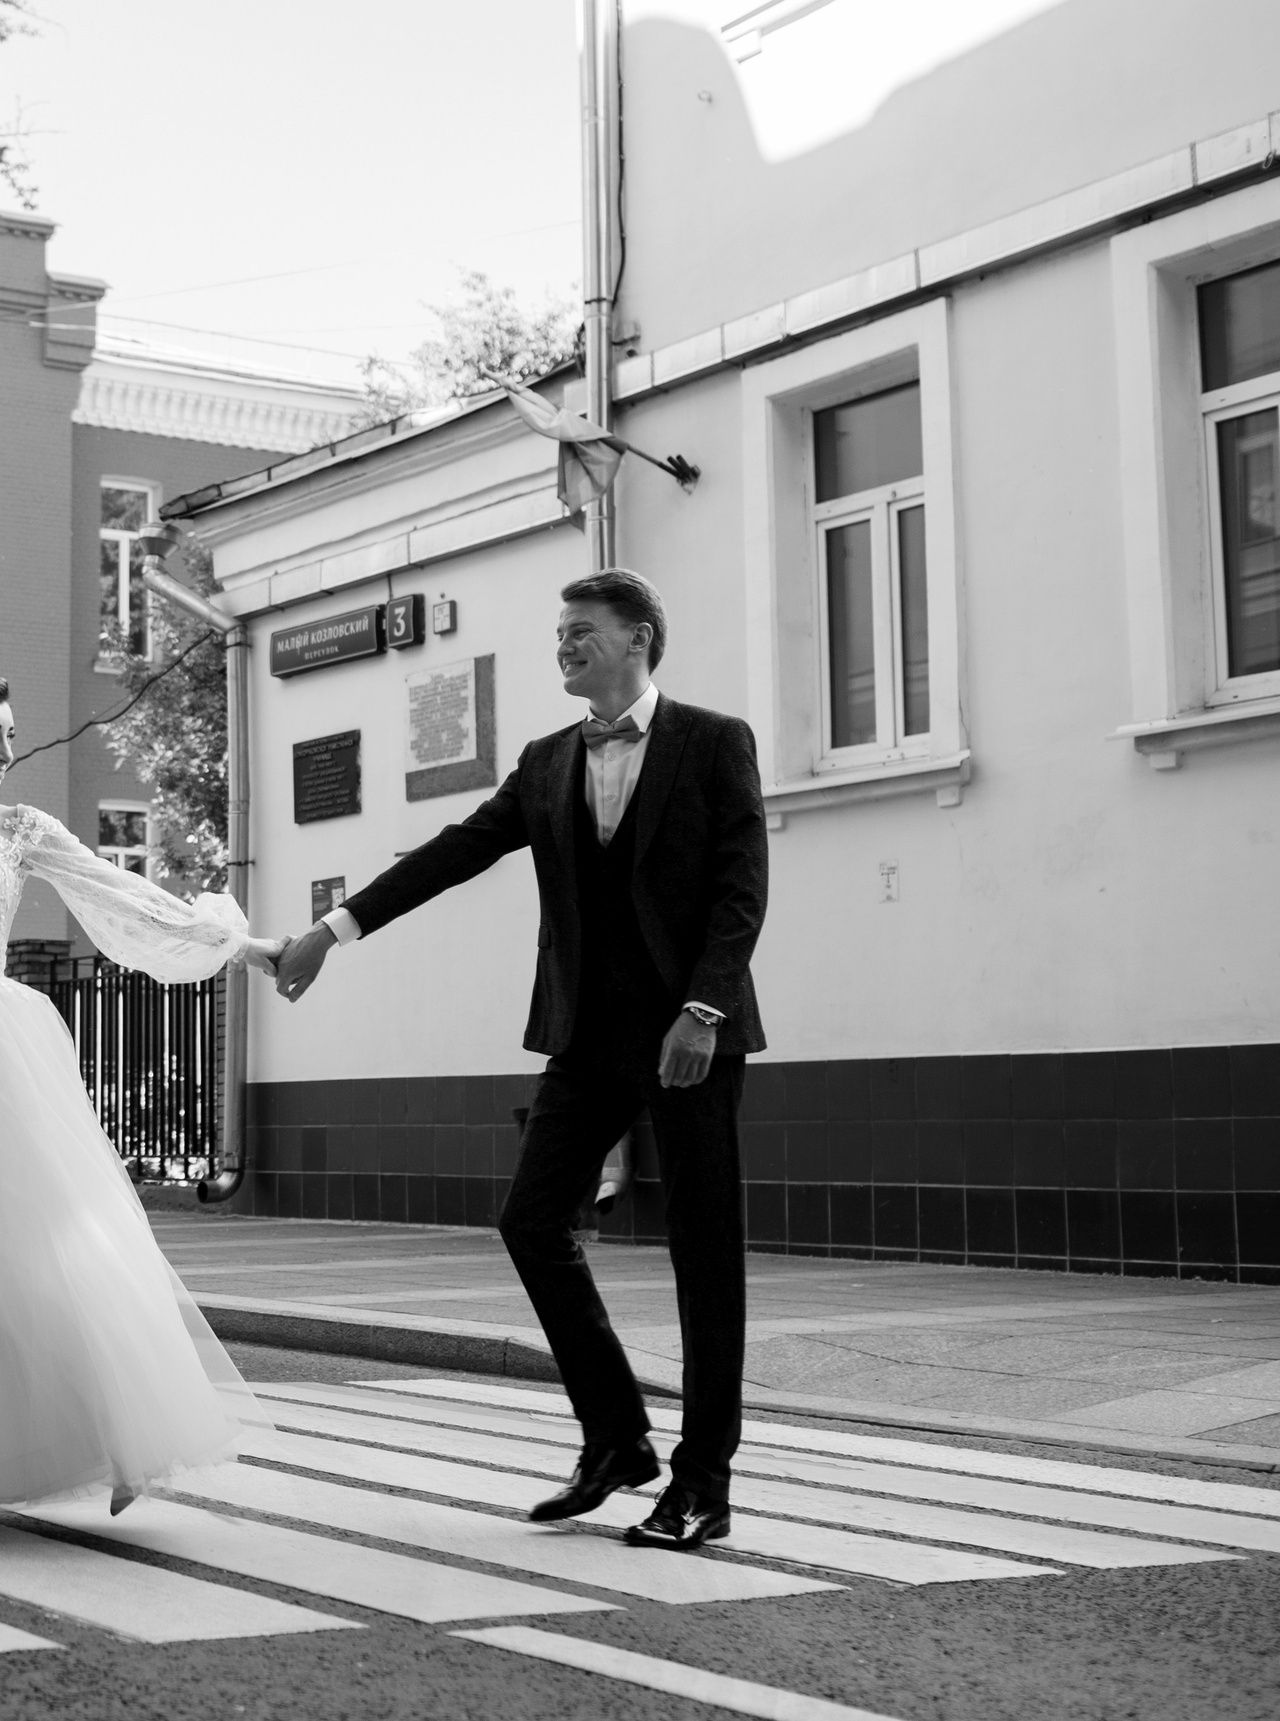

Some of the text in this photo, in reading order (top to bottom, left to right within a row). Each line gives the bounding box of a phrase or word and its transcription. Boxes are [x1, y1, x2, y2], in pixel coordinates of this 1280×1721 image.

[277, 615, 369, 653] МАЛЫЙ КОЗЛОВСКИЙ
[394, 606, 406, 637] 3
[304, 645, 340, 660] ПЕРЕУЛОК
